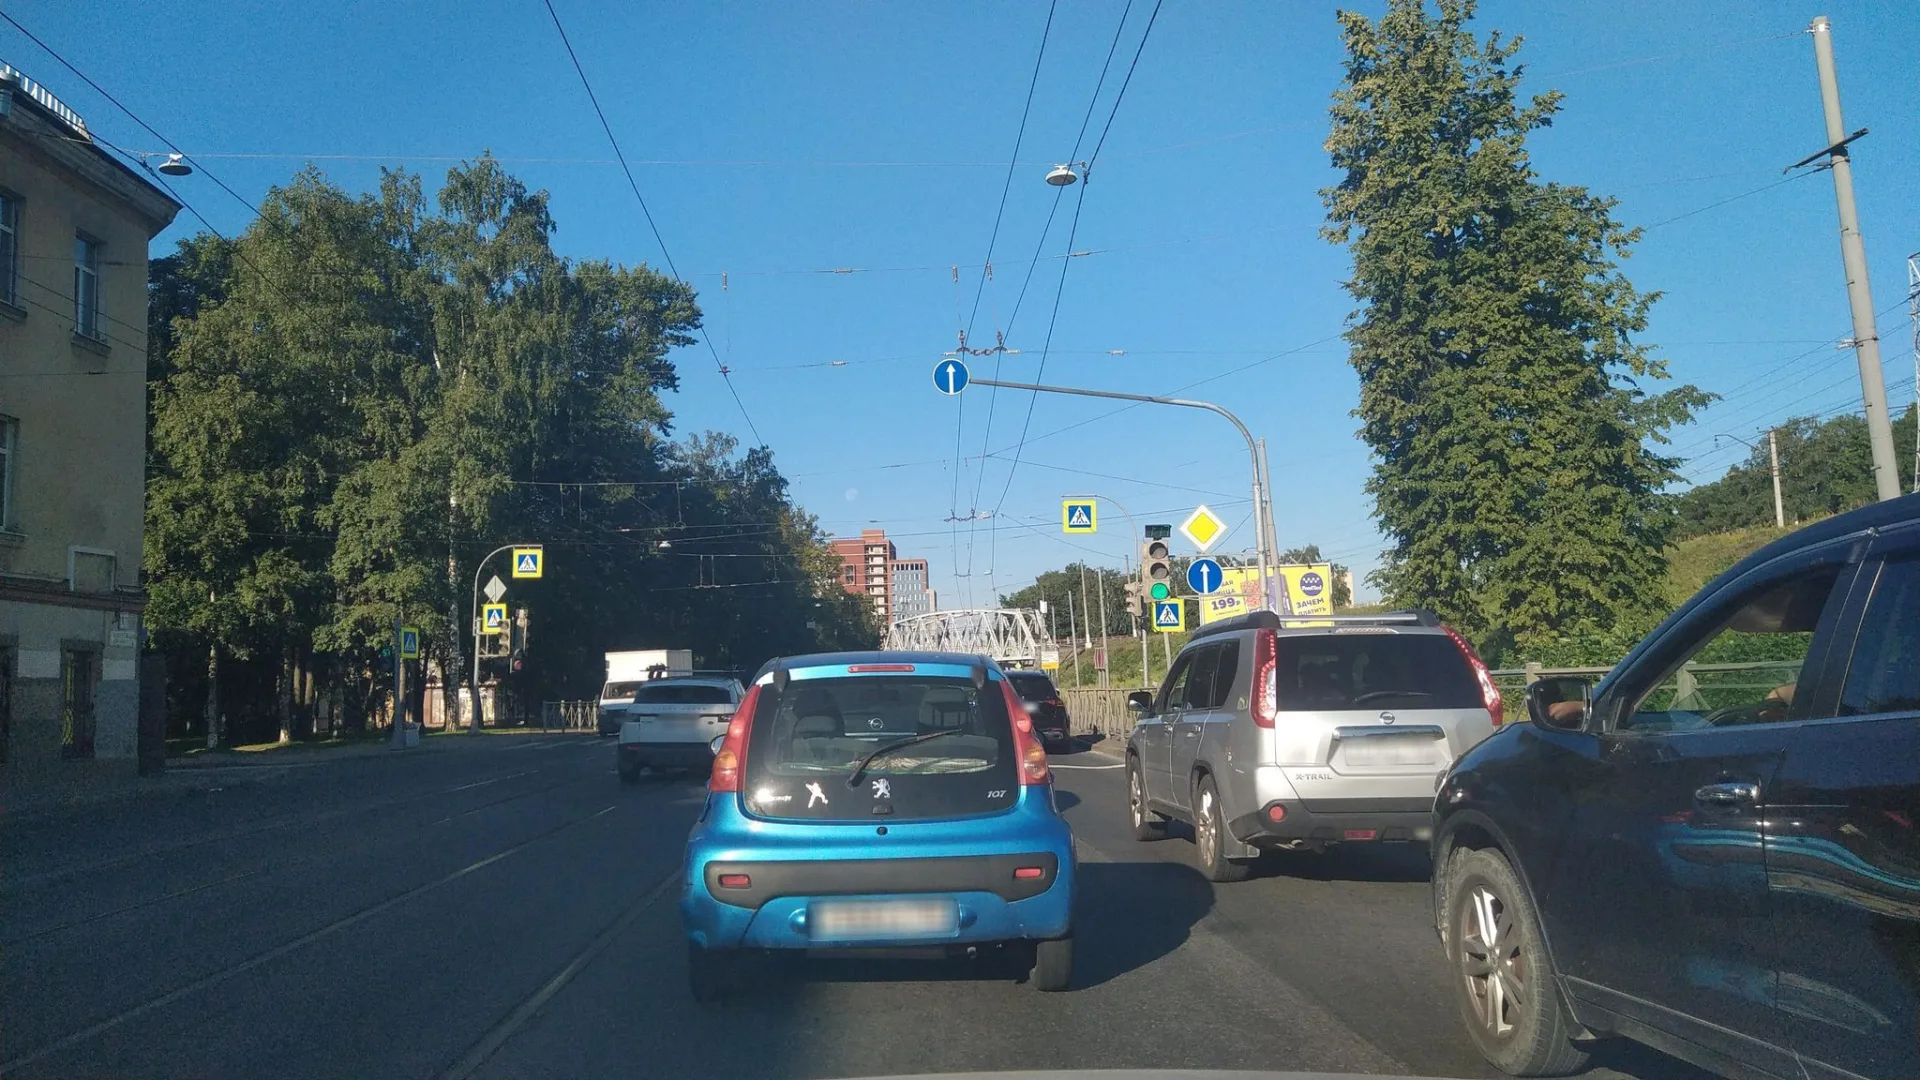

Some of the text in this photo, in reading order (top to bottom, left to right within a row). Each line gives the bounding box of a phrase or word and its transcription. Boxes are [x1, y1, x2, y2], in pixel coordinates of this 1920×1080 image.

[1296, 598, 1325, 609] ЗАЧЕМ
[1295, 773, 1333, 781] X-TRAIL
[987, 790, 1007, 798] 107
